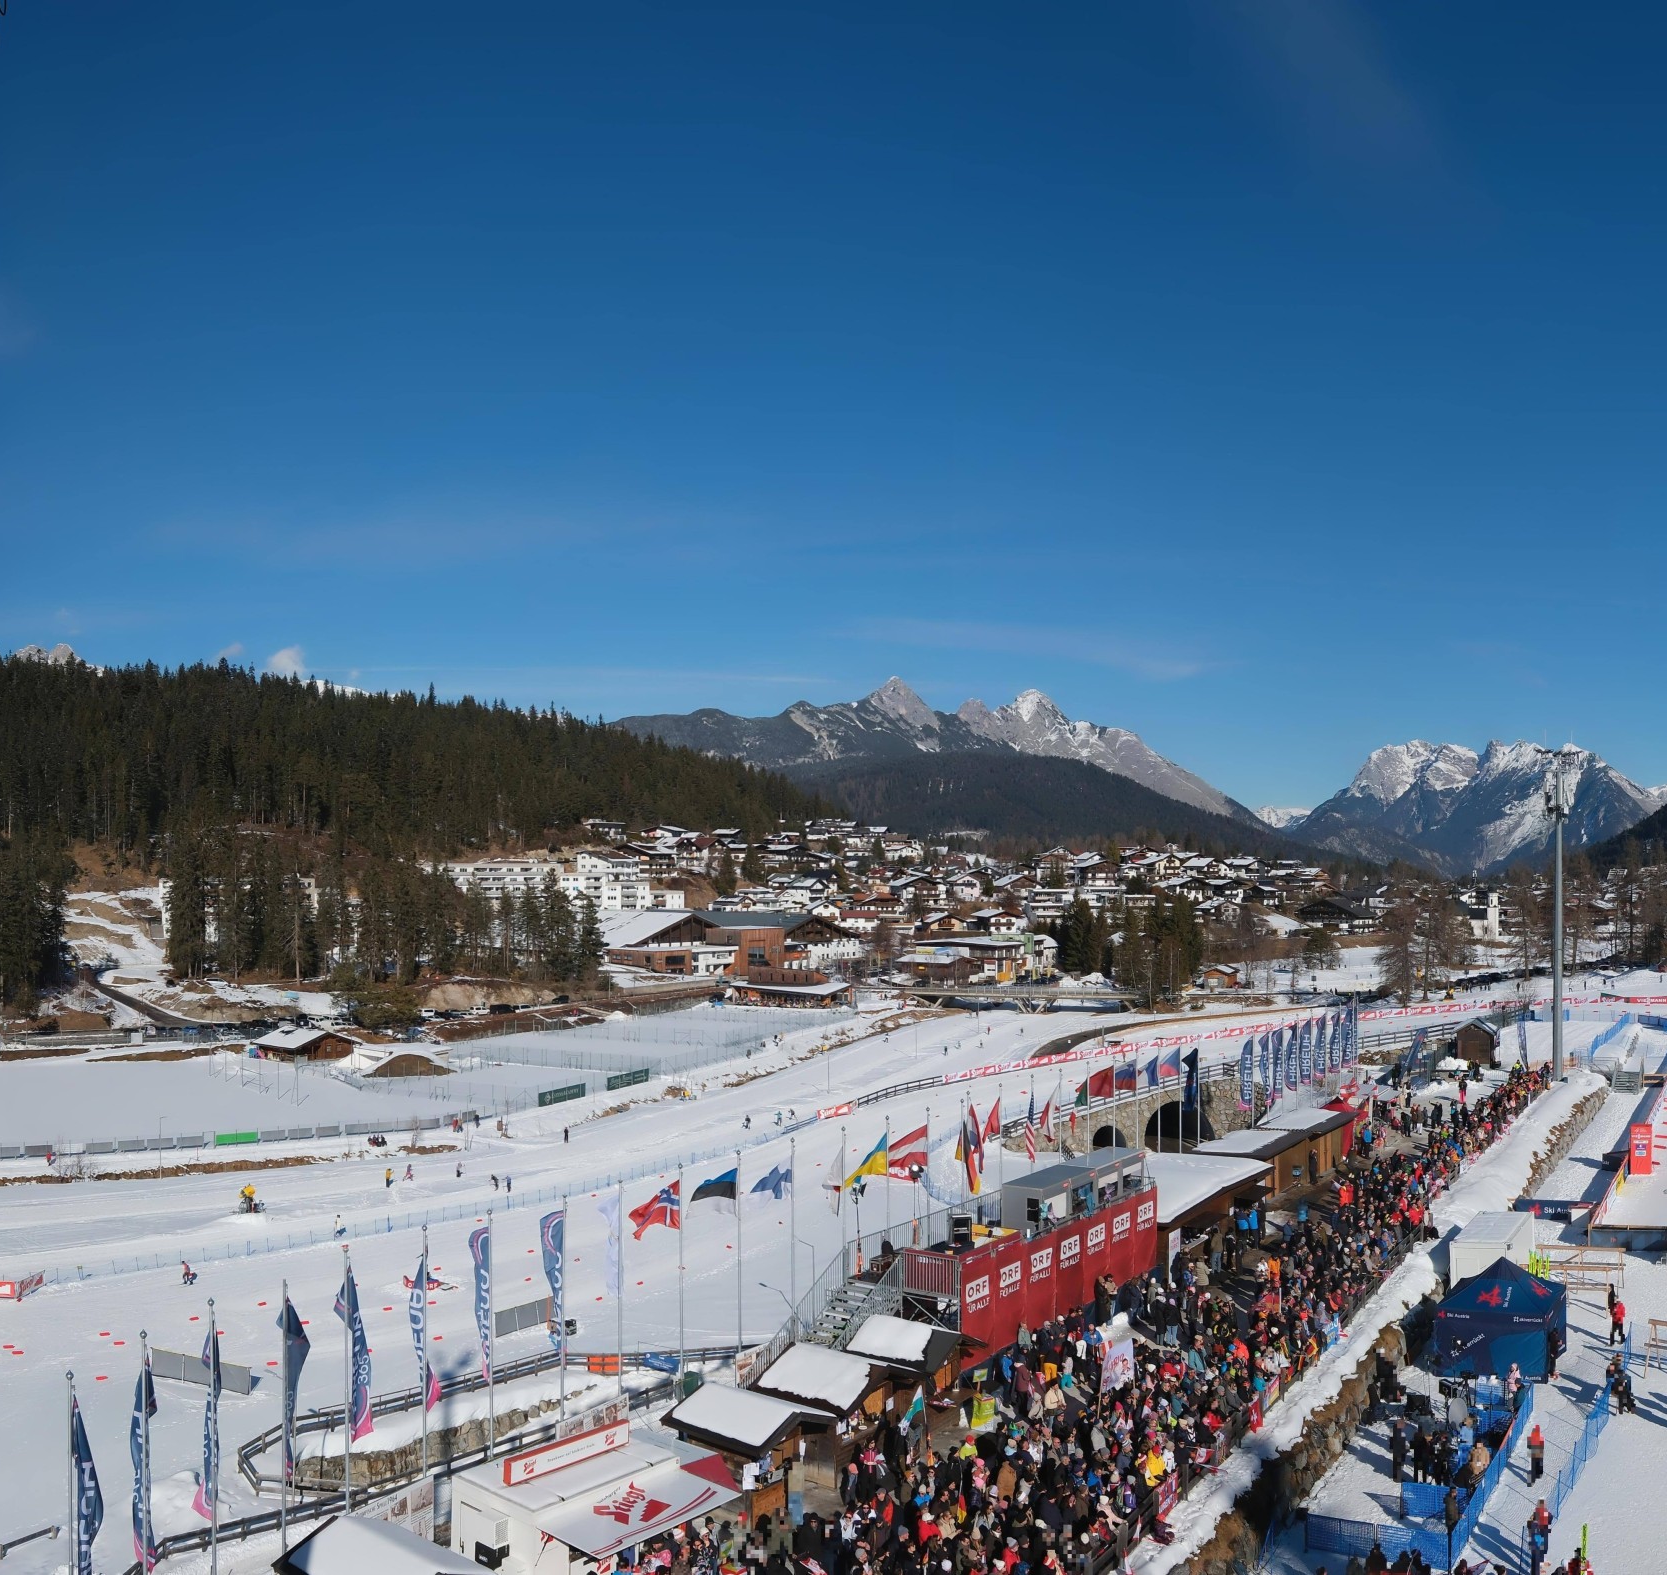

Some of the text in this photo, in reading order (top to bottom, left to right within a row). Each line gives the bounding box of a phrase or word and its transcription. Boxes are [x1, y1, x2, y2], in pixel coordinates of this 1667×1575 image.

[1139, 1205, 1152, 1218] ORF
[1544, 1206, 1555, 1214] Ski
[1115, 1216, 1129, 1230] ORF
[1090, 1227, 1104, 1242] ORF
[1063, 1239, 1078, 1255] ORF
[1033, 1252, 1051, 1268] ORF
[1002, 1266, 1019, 1282] ORF
[968, 1280, 987, 1298] ORF
[358, 1355, 369, 1383] 365
[593, 1481, 646, 1525] Stiegl
